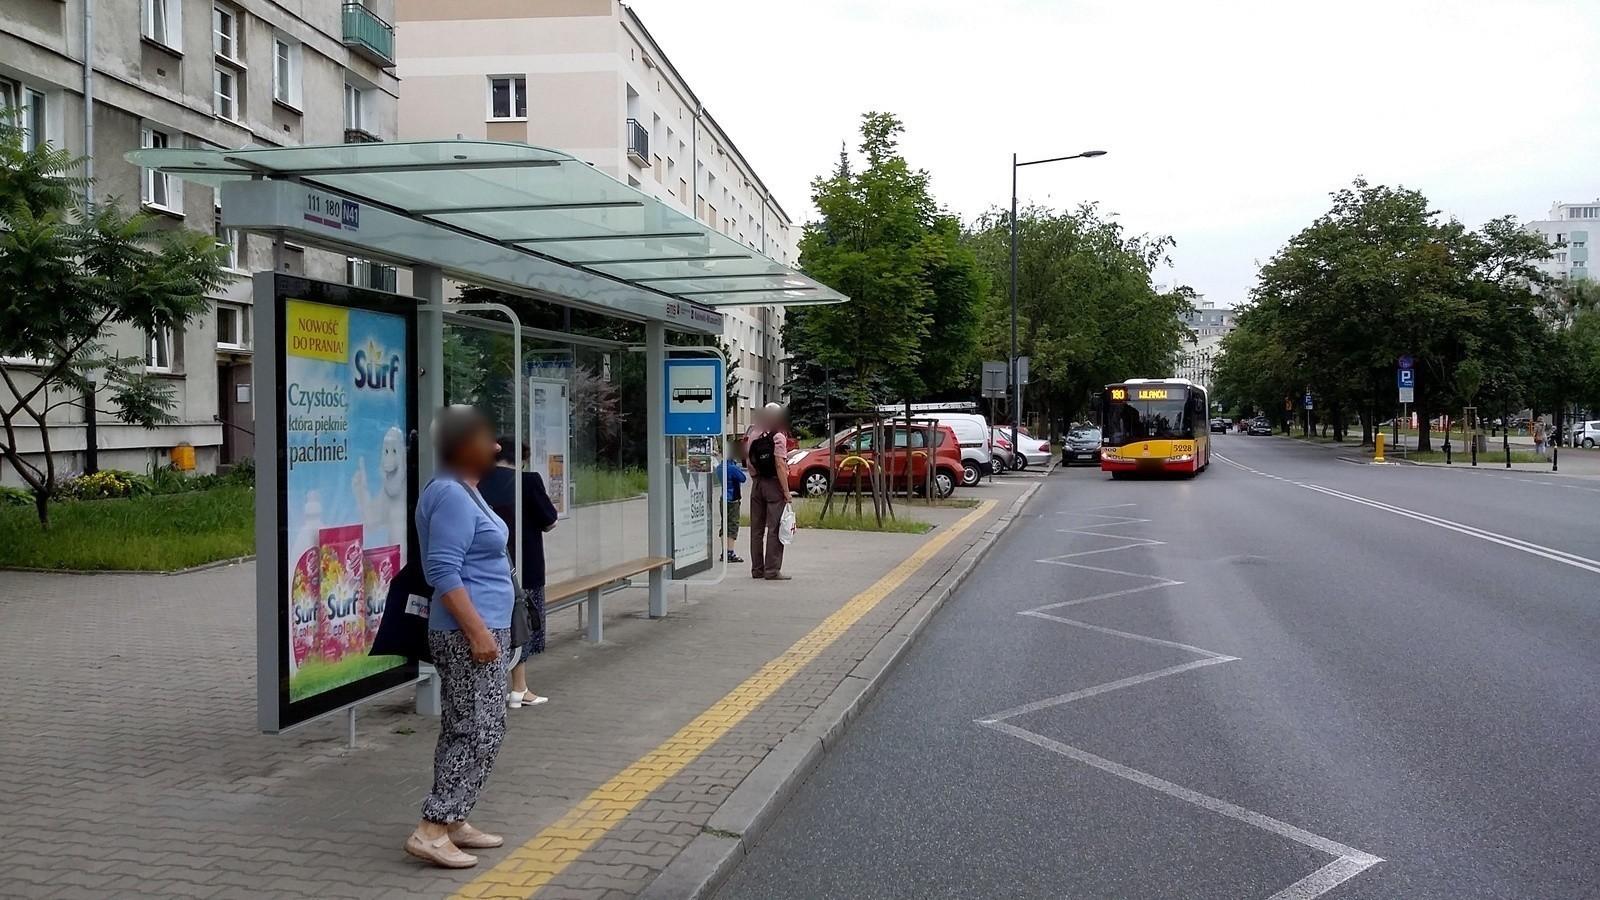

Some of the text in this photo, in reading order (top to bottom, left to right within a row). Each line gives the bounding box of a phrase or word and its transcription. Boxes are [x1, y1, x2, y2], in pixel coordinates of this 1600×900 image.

[308, 194, 340, 217] 111 180
[343, 204, 358, 223] N41
[298, 317, 339, 336] NOWOŚĆ
[293, 336, 344, 354] DO PRANIA!
[354, 350, 400, 392] Surf
[1401, 370, 1411, 382] P
[288, 383, 348, 413] Czystość,
[1112, 390, 1124, 399] 180
[288, 415, 348, 435] która pięknie
[289, 438, 348, 470] pachnie!
[1173, 444, 1191, 452] 5228
[295, 602, 318, 625] Surf
[328, 591, 359, 620] Surf
[367, 596, 385, 616] Sur
